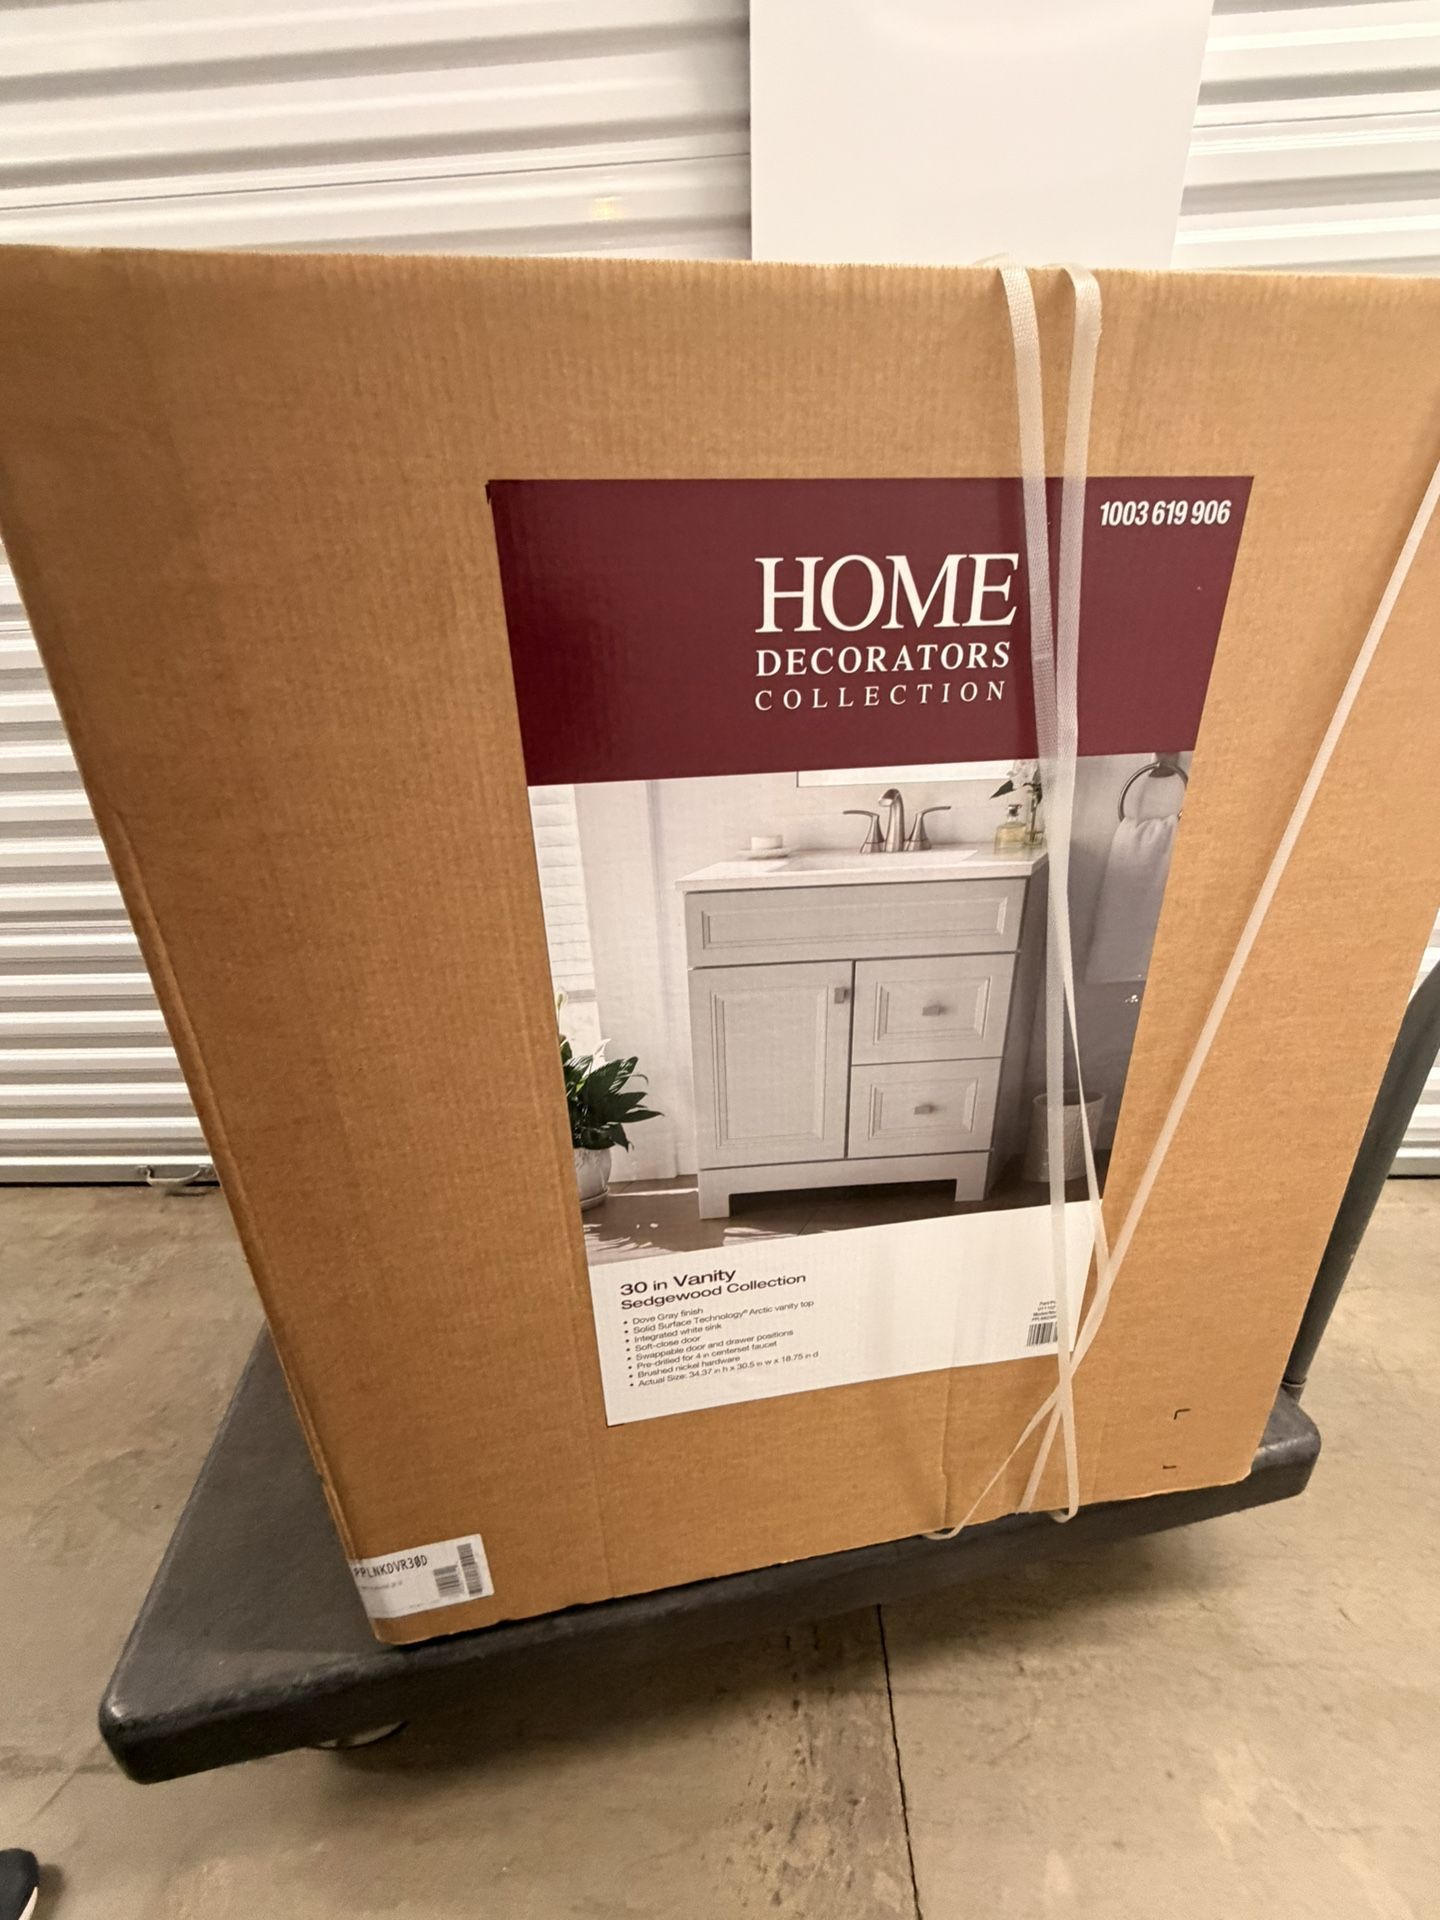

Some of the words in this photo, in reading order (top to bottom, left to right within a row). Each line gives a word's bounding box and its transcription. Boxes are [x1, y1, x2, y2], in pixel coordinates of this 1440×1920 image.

[1100, 500, 1148, 526] 1003
[1151, 500, 1189, 526] 619
[1191, 500, 1231, 525] 906
[754, 553, 1019, 634] HOME
[755, 641, 1011, 677] DECORATORS
[754, 680, 1006, 712] COLLECTION
[620, 1281, 647, 1296] 30
[653, 1280, 667, 1291] in
[673, 1269, 736, 1288] Vanity
[621, 1286, 722, 1310] Sedgewood
[727, 1274, 807, 1293] Collection
[632, 1316, 656, 1325] Dove
[657, 1312, 679, 1321] Gray
[681, 1308, 704, 1317] finish
[633, 1325, 656, 1334] Solid
[658, 1320, 692, 1330] Surface
[749, 1306, 773, 1316] Arctic
[775, 1301, 799, 1311] vanity
[800, 1300, 815, 1309] top
[634, 1330, 678, 1343] Integrated
[680, 1326, 703, 1336] white
[705, 1323, 722, 1332] sink
[635, 1340, 679, 1352] Soft-close
[681, 1335, 702, 1344] door
[636, 1348, 684, 1361] Swappable
[686, 1343, 706, 1352] door
[708, 1339, 724, 1347] and
[726, 1335, 754, 1345] drawer
[756, 1330, 794, 1342] positions
[637, 1357, 680, 1369] Pre-drilled
[682, 1353, 694, 1361] for
[696, 1352, 702, 1360] 4
[711, 1345, 750, 1357] centerset
[752, 1340, 777, 1350] faucet
[637, 1366, 674, 1378] Brushed
[675, 1362, 700, 1372] nickel
[701, 1355, 741, 1367] hardware
[638, 1376, 665, 1387] Actual
[722, 1365, 729, 1373] h
